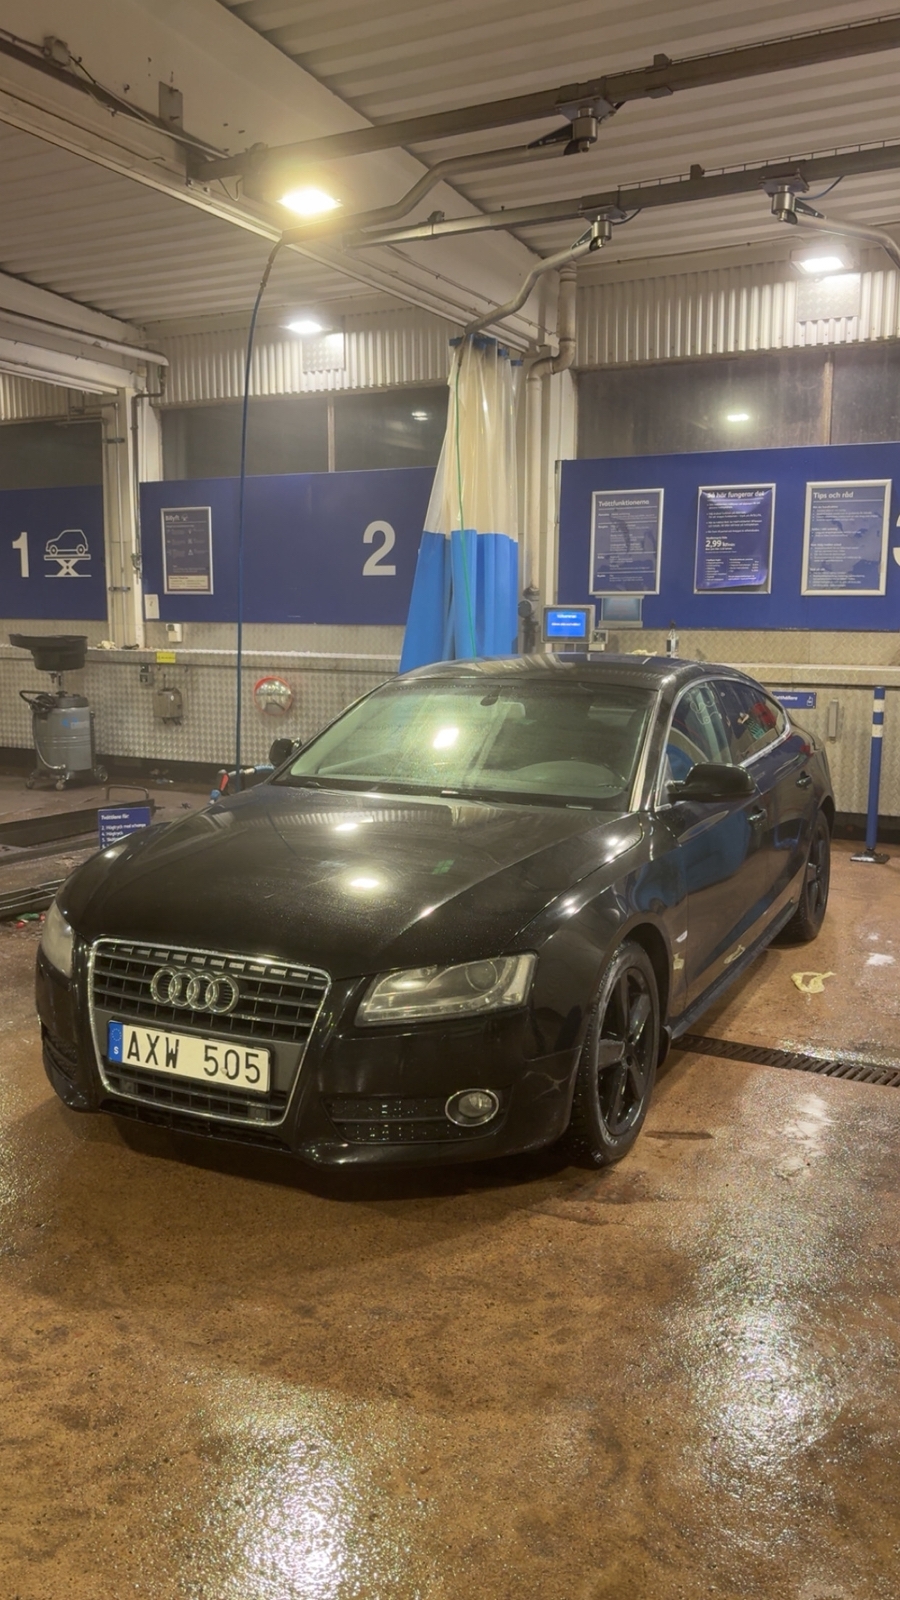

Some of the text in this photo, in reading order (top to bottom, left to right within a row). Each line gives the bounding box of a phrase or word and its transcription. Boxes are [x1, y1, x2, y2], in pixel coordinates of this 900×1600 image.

[728, 491, 754, 499] fungerar
[813, 492, 827, 500] Tips
[598, 499, 650, 507] Tvättfunktionerna
[362, 520, 397, 576] 2
[705, 539, 722, 548] 2,99
[12, 532, 29, 578] 1
[113, 1046, 119, 1055] S
[127, 1031, 261, 1084] AXW 505
